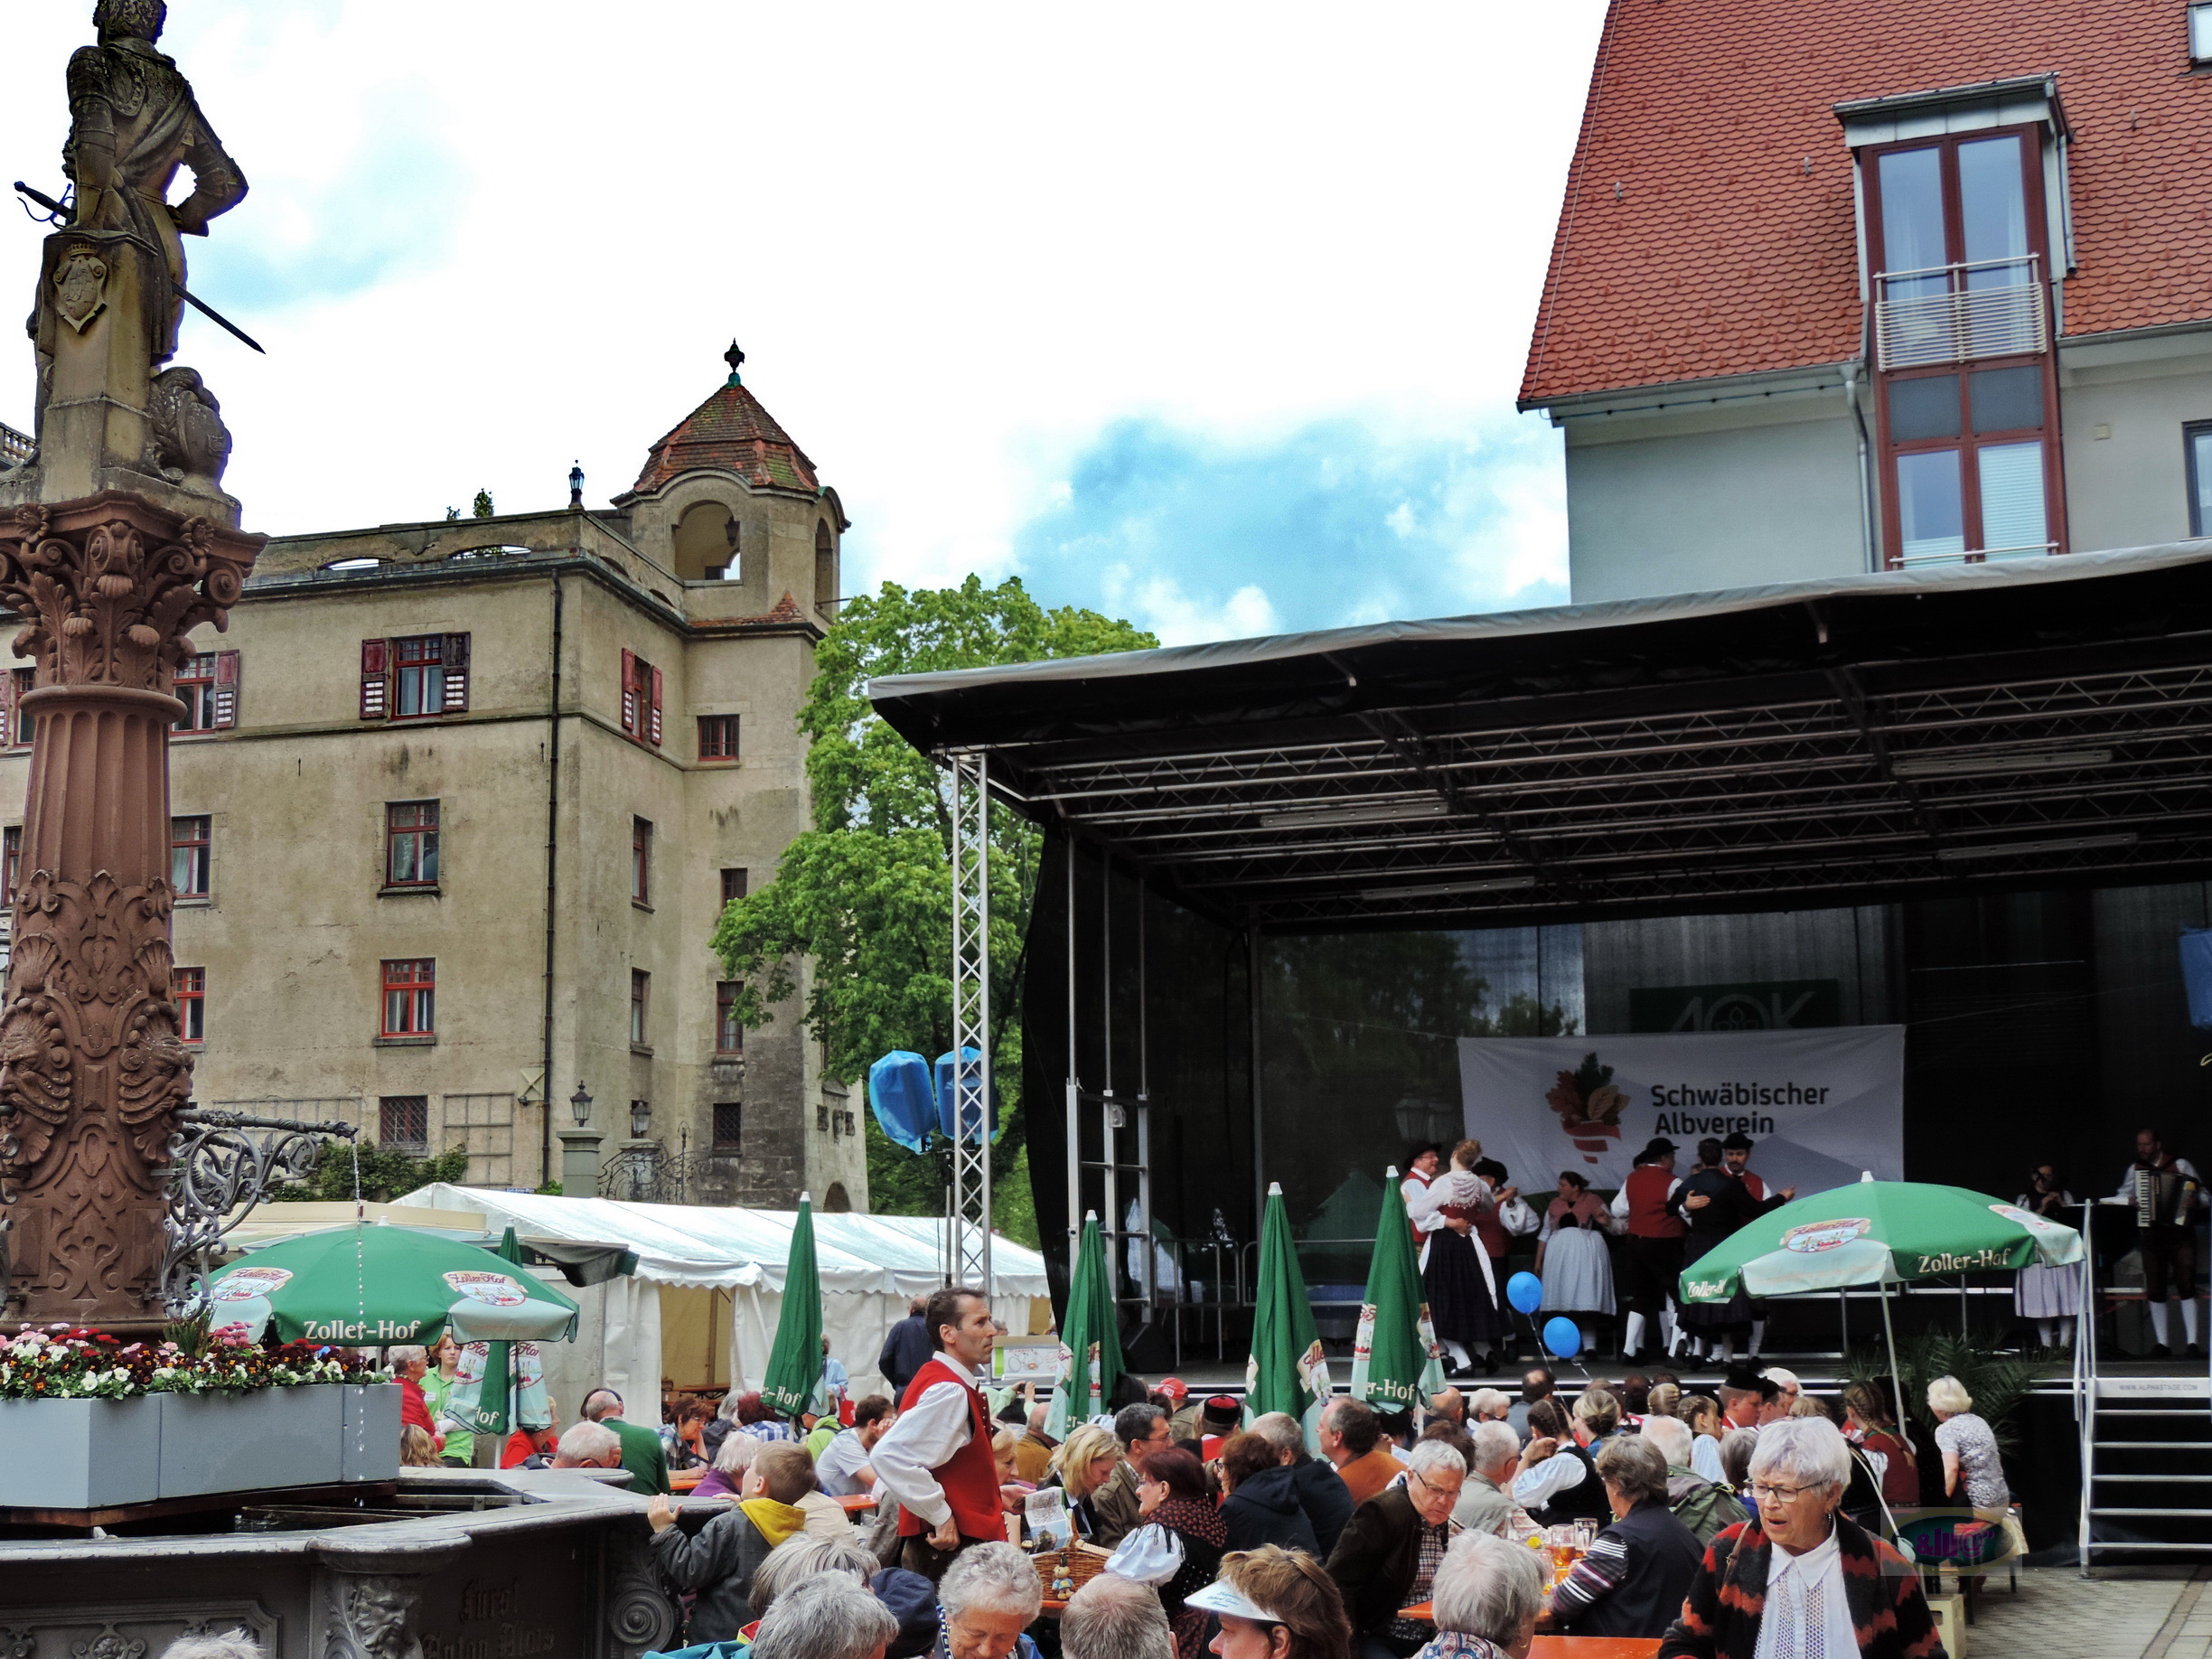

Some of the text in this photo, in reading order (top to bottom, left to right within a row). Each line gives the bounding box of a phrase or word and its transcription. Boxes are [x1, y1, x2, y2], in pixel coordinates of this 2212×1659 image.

[1651, 1082, 1830, 1107] Schwäbischer
[1654, 1111, 1774, 1135] Albverein
[1917, 1247, 2011, 1273] Zoller-Hof
[304, 1319, 422, 1340] Zoller-Hof
